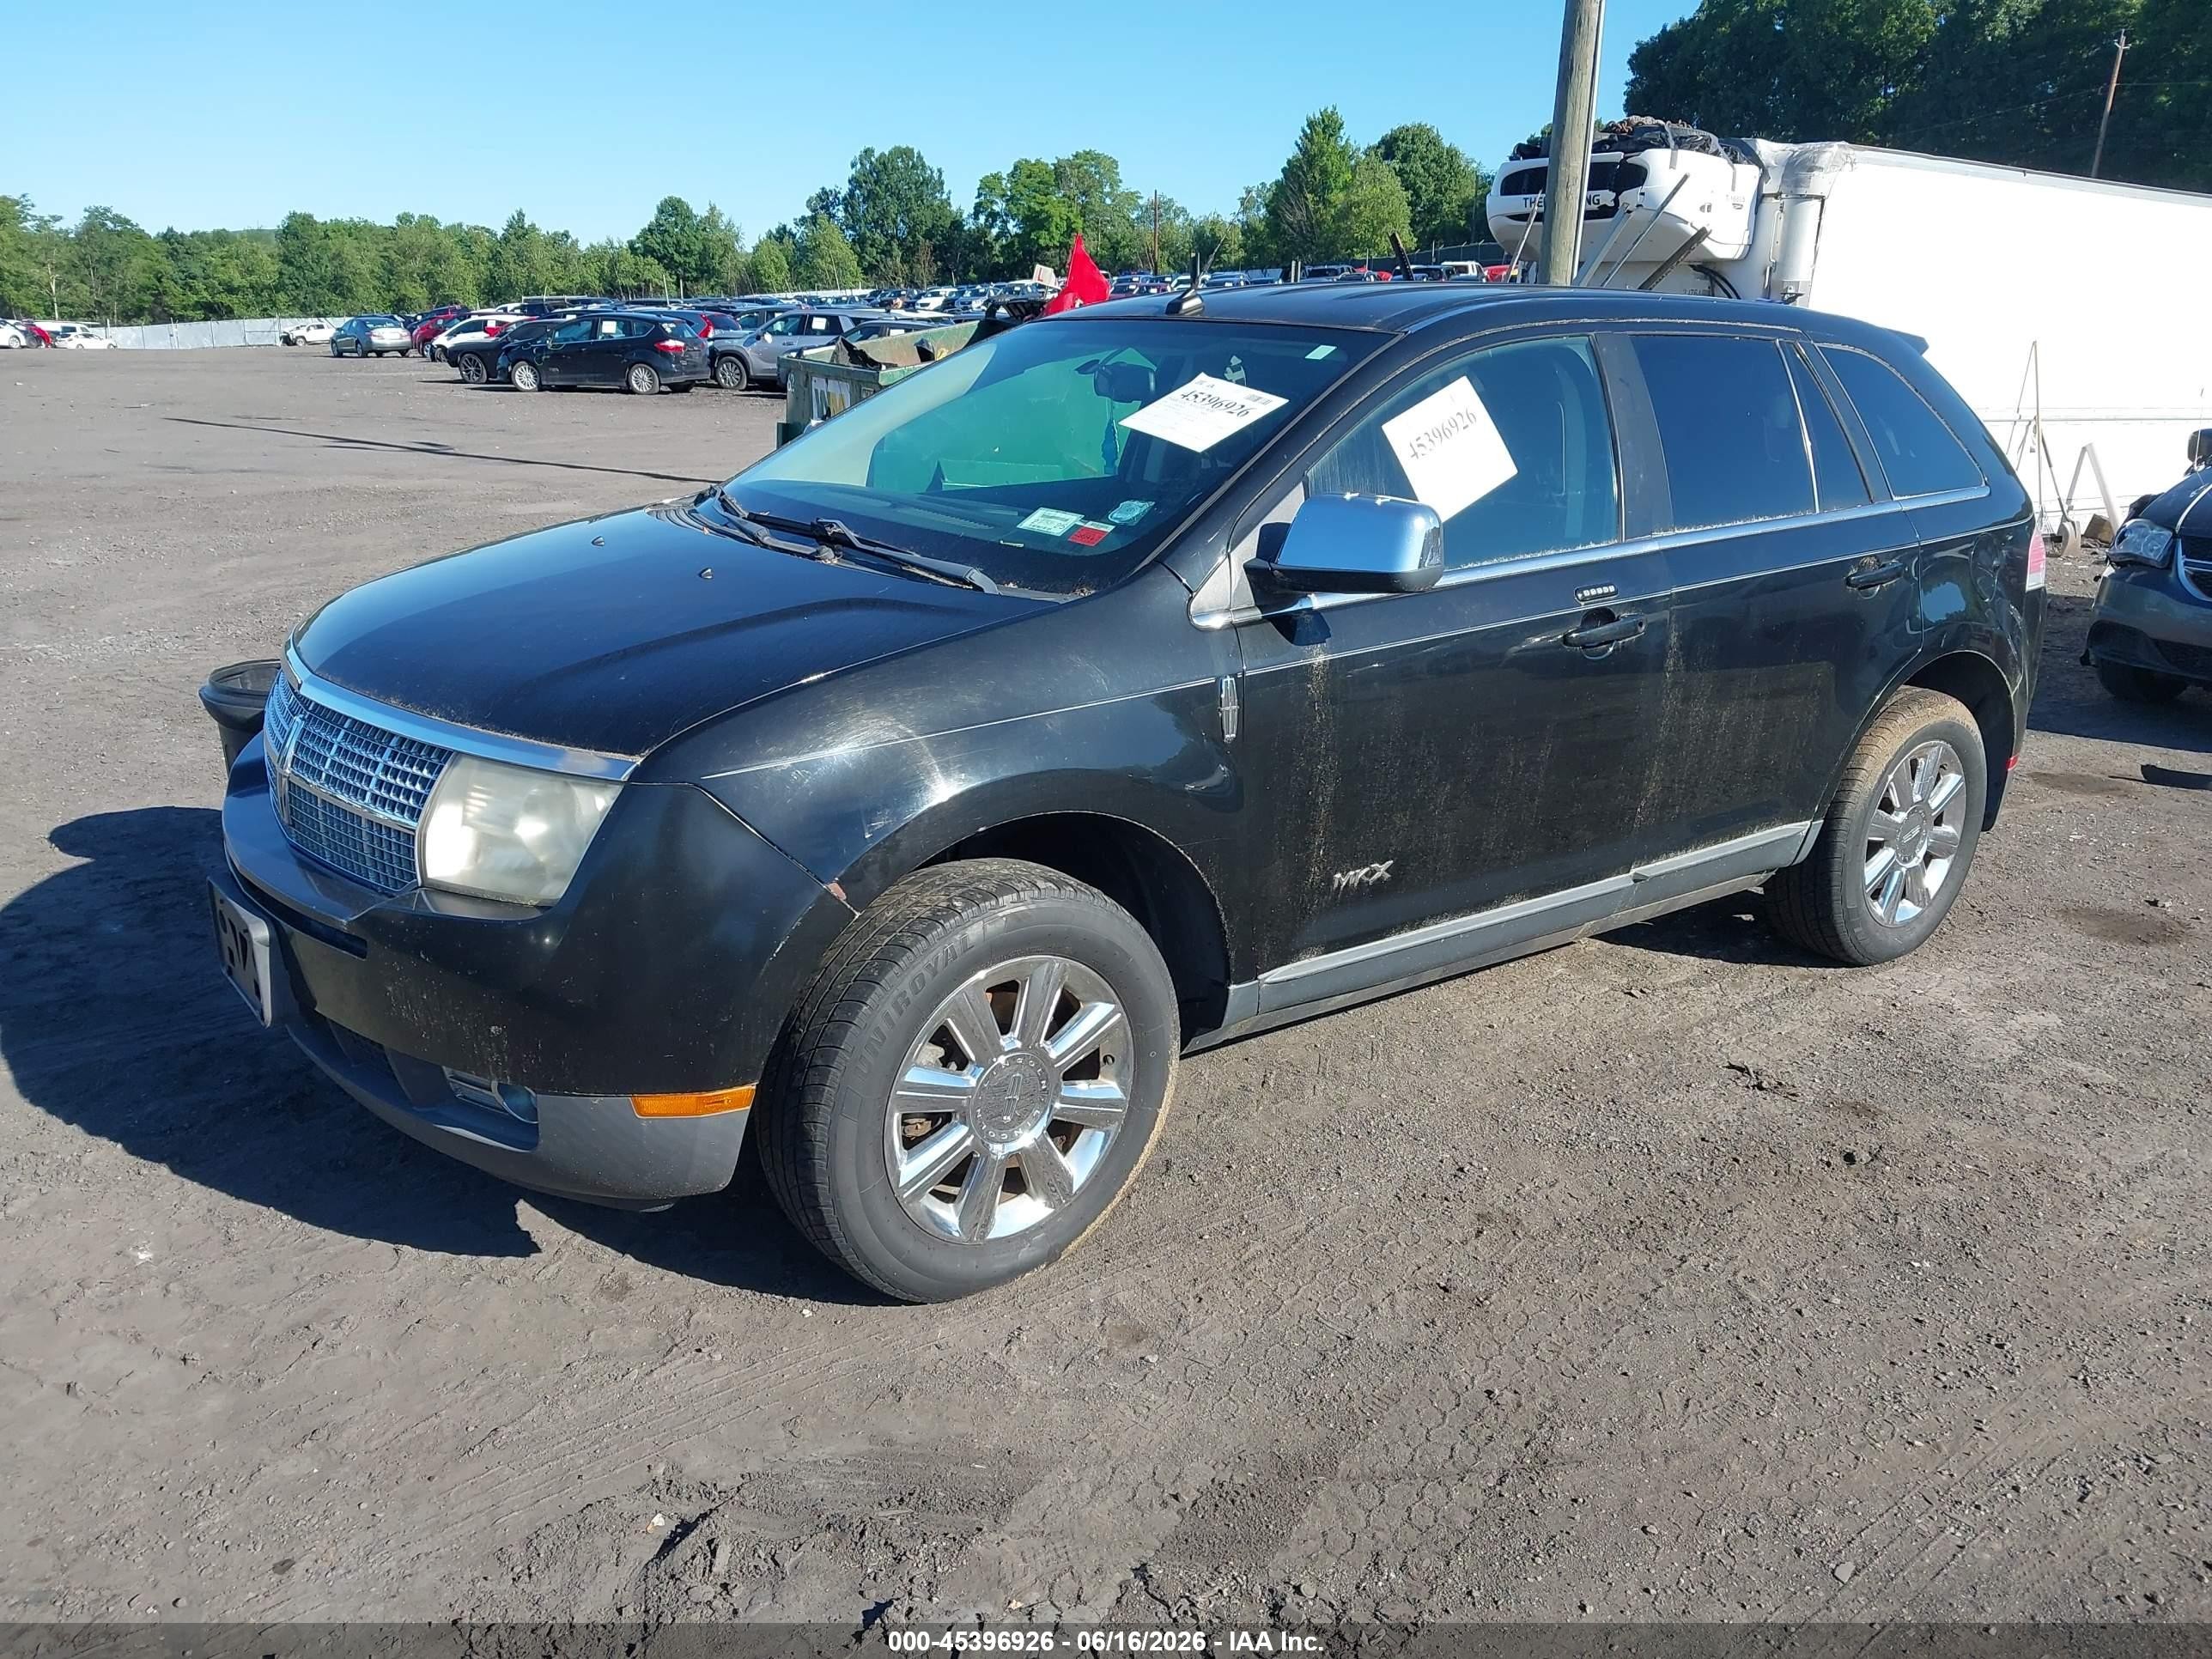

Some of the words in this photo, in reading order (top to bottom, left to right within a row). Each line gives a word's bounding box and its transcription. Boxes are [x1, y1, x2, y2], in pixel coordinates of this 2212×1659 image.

[1181, 389, 1257, 418] 45396926
[1408, 405, 1478, 460] 45396926
[855, 933, 975, 1082] UNIROYAL
